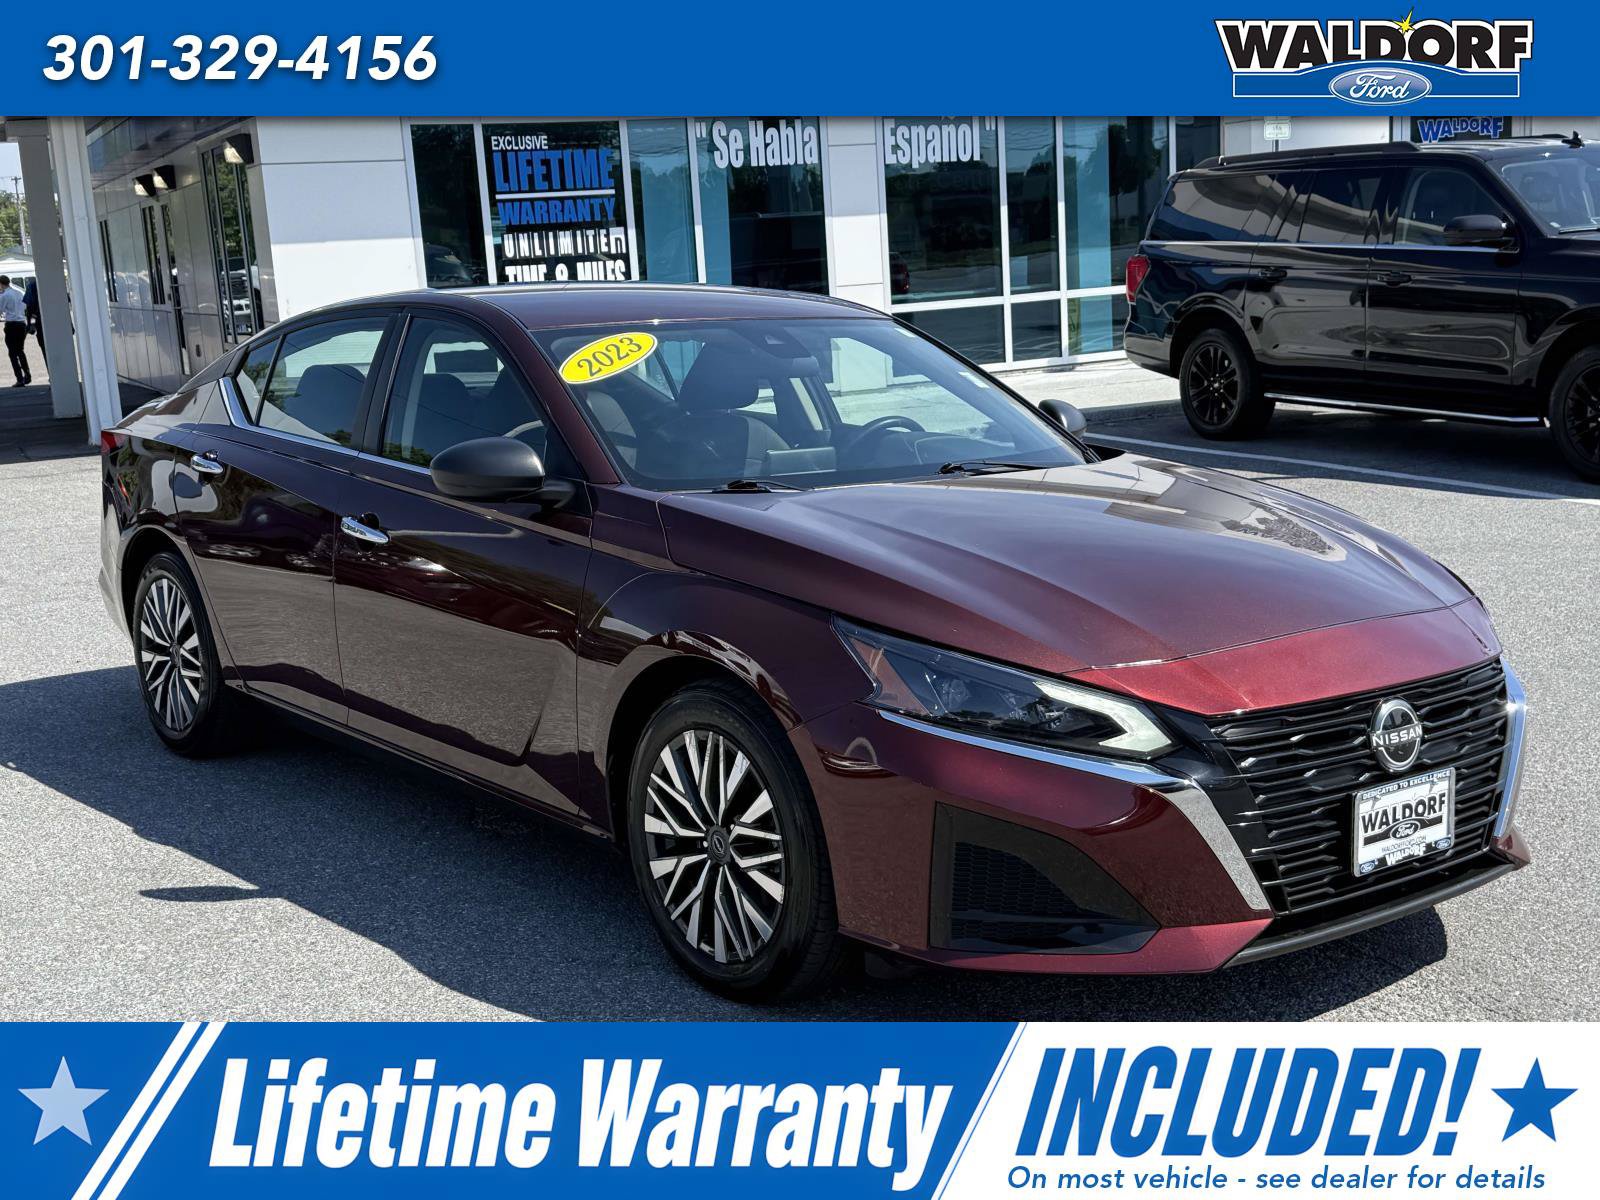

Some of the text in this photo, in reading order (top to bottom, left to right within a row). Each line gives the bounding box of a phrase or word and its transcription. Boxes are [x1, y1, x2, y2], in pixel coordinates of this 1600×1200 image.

[491, 135, 549, 150] EXCLUSIVE
[748, 119, 819, 167] Habla
[1417, 117, 1504, 144] WALDORF
[493, 147, 615, 192] LIFETIME
[498, 198, 616, 225] WARRANTY
[577, 337, 643, 378] 2023
[1372, 725, 1423, 747] NISSAN
[1362, 770, 1451, 800] DEDICATED TO EXCELLENCE
[1361, 792, 1447, 834] WALDORF
[1395, 823, 1415, 838] Ford
[1385, 843, 1427, 866] WALDORF
